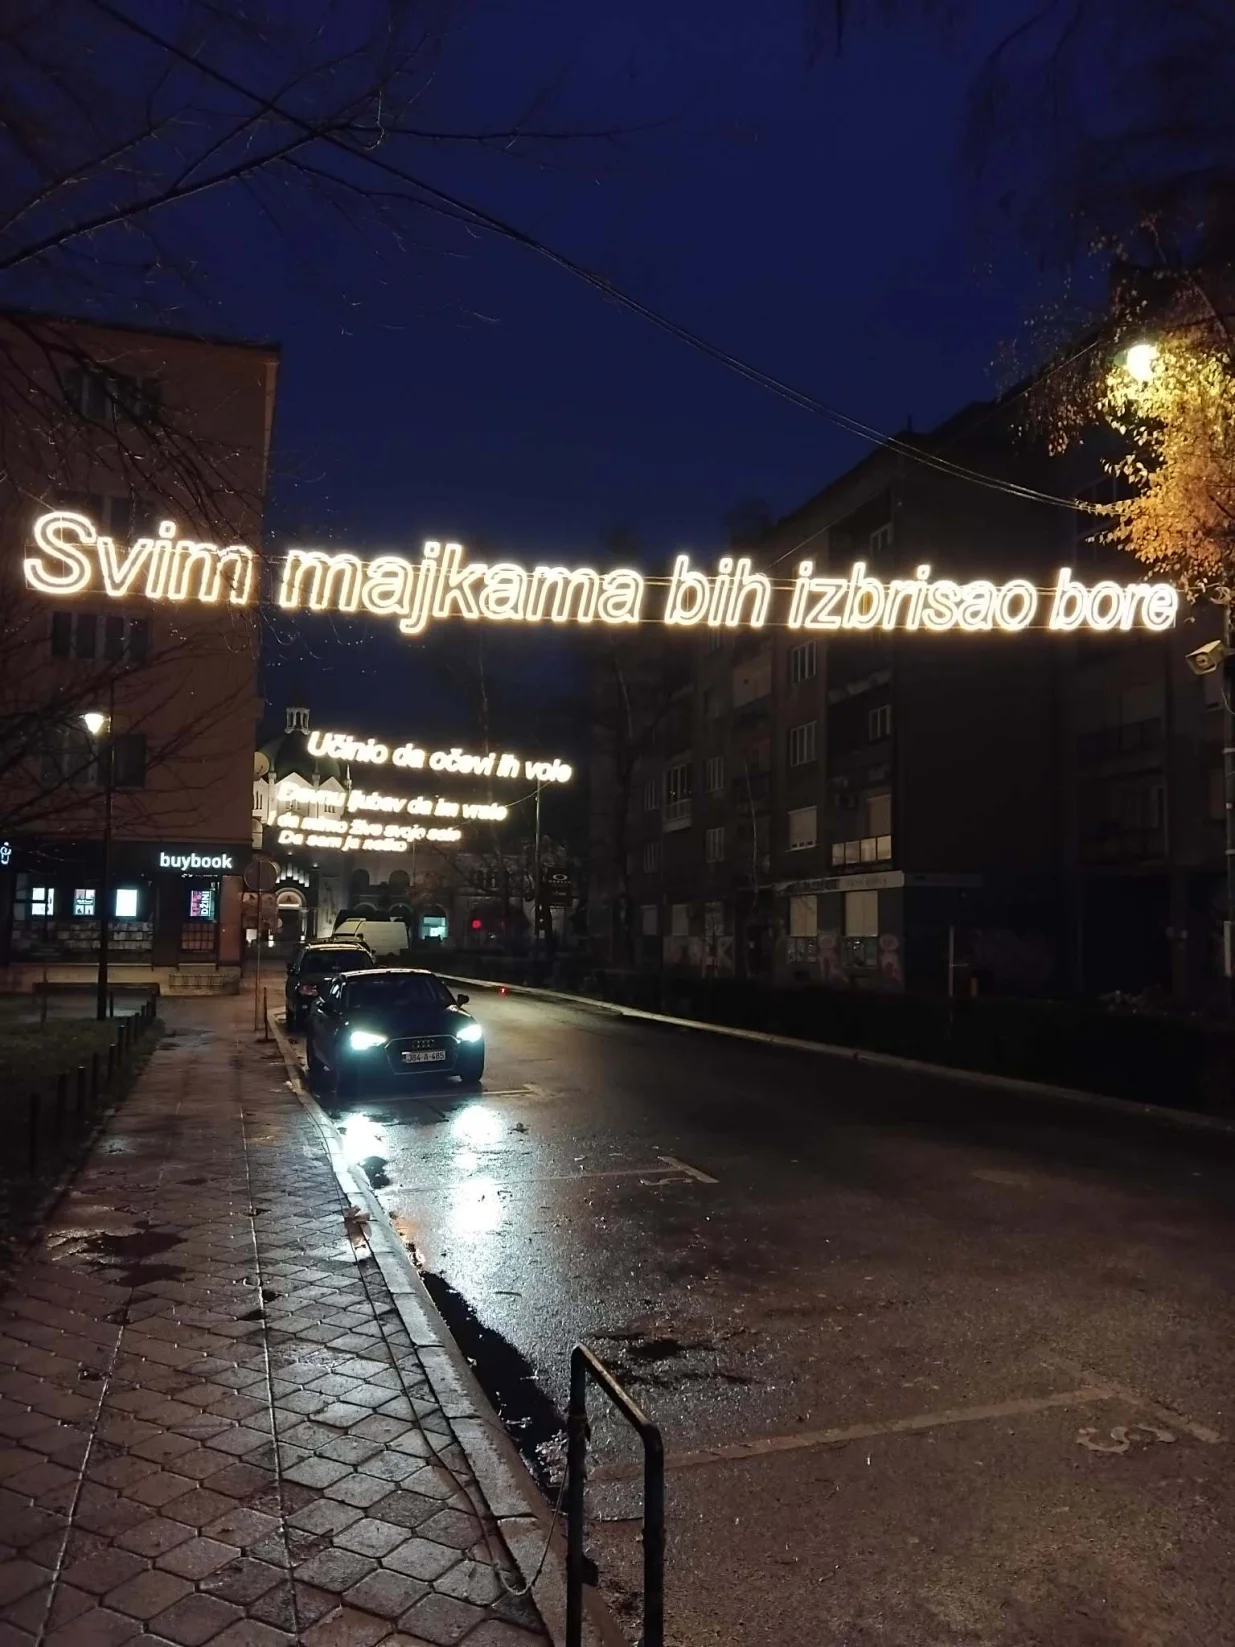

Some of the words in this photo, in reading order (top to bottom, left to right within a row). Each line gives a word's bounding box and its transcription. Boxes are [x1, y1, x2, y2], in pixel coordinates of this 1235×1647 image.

[23, 510, 256, 605] Svim
[277, 540, 645, 635] majkama
[663, 553, 772, 629] bih
[786, 559, 1038, 633] izbrisao
[1047, 566, 1179, 633] bore
[307, 730, 389, 765] Učinio
[392, 743, 427, 769] da
[407, 796, 434, 815] da
[160, 852, 232, 871] buybook
